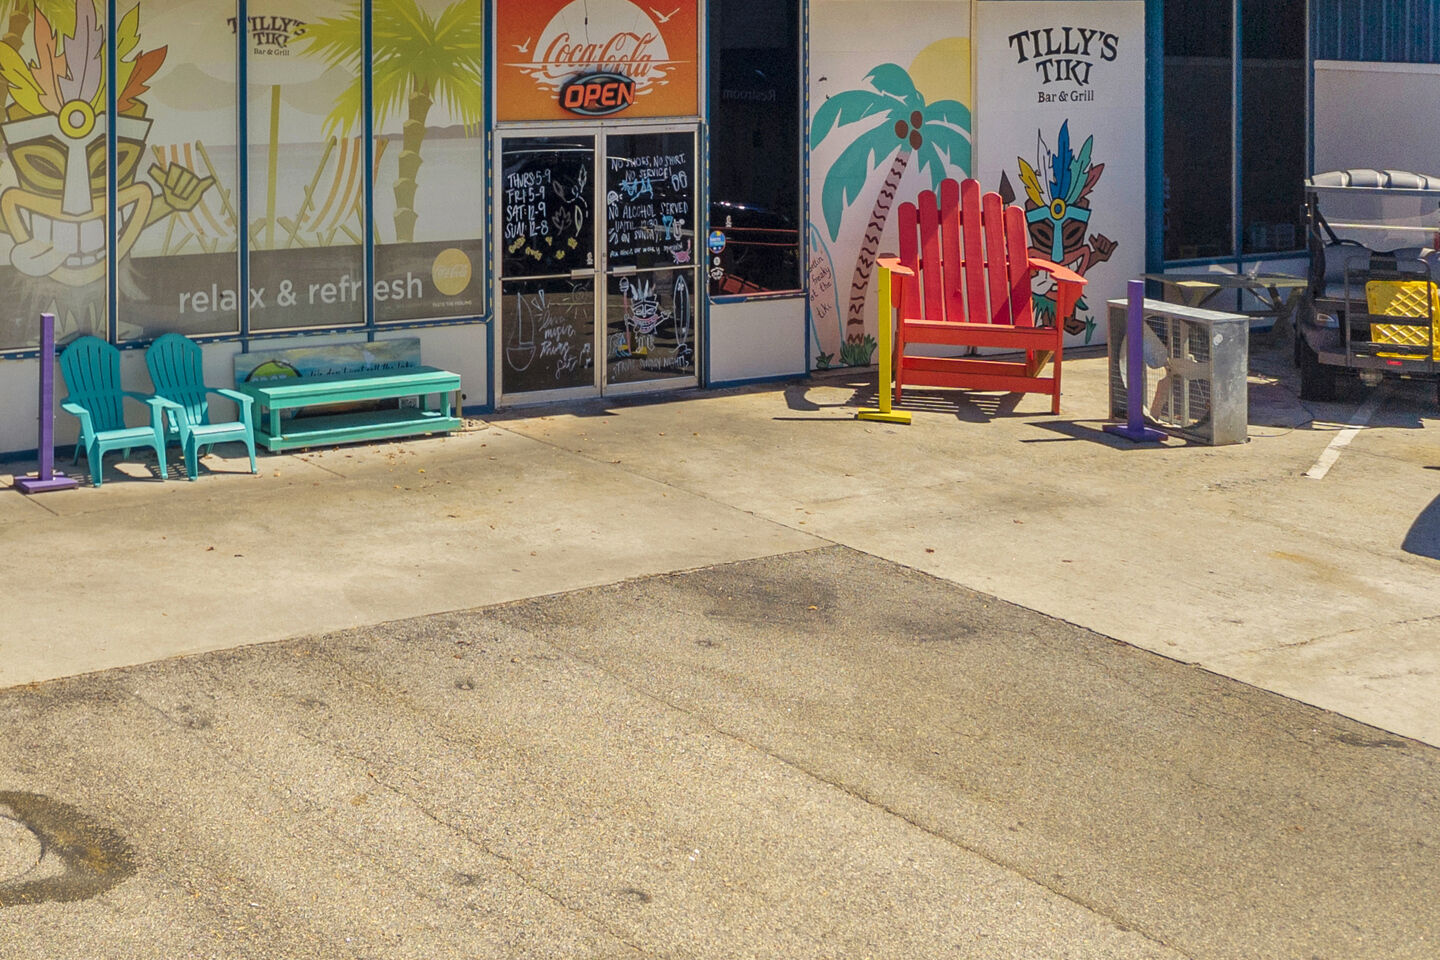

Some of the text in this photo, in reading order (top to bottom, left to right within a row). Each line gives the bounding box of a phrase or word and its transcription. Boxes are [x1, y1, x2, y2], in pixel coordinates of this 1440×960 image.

[542, 32, 659, 79] Coca-Cola
[1008, 26, 1119, 64] TILLY'S
[1035, 58, 1093, 86] TIKI
[564, 82, 636, 108] OPEN
[1038, 90, 1094, 103] Bar & Grill
[611, 159, 623, 171] NO
[653, 156, 663, 167] NO
[625, 170, 636, 181] NO
[608, 201, 688, 220] NO ALCOHOL SERVED
[179, 271, 423, 313] relax & refresh
